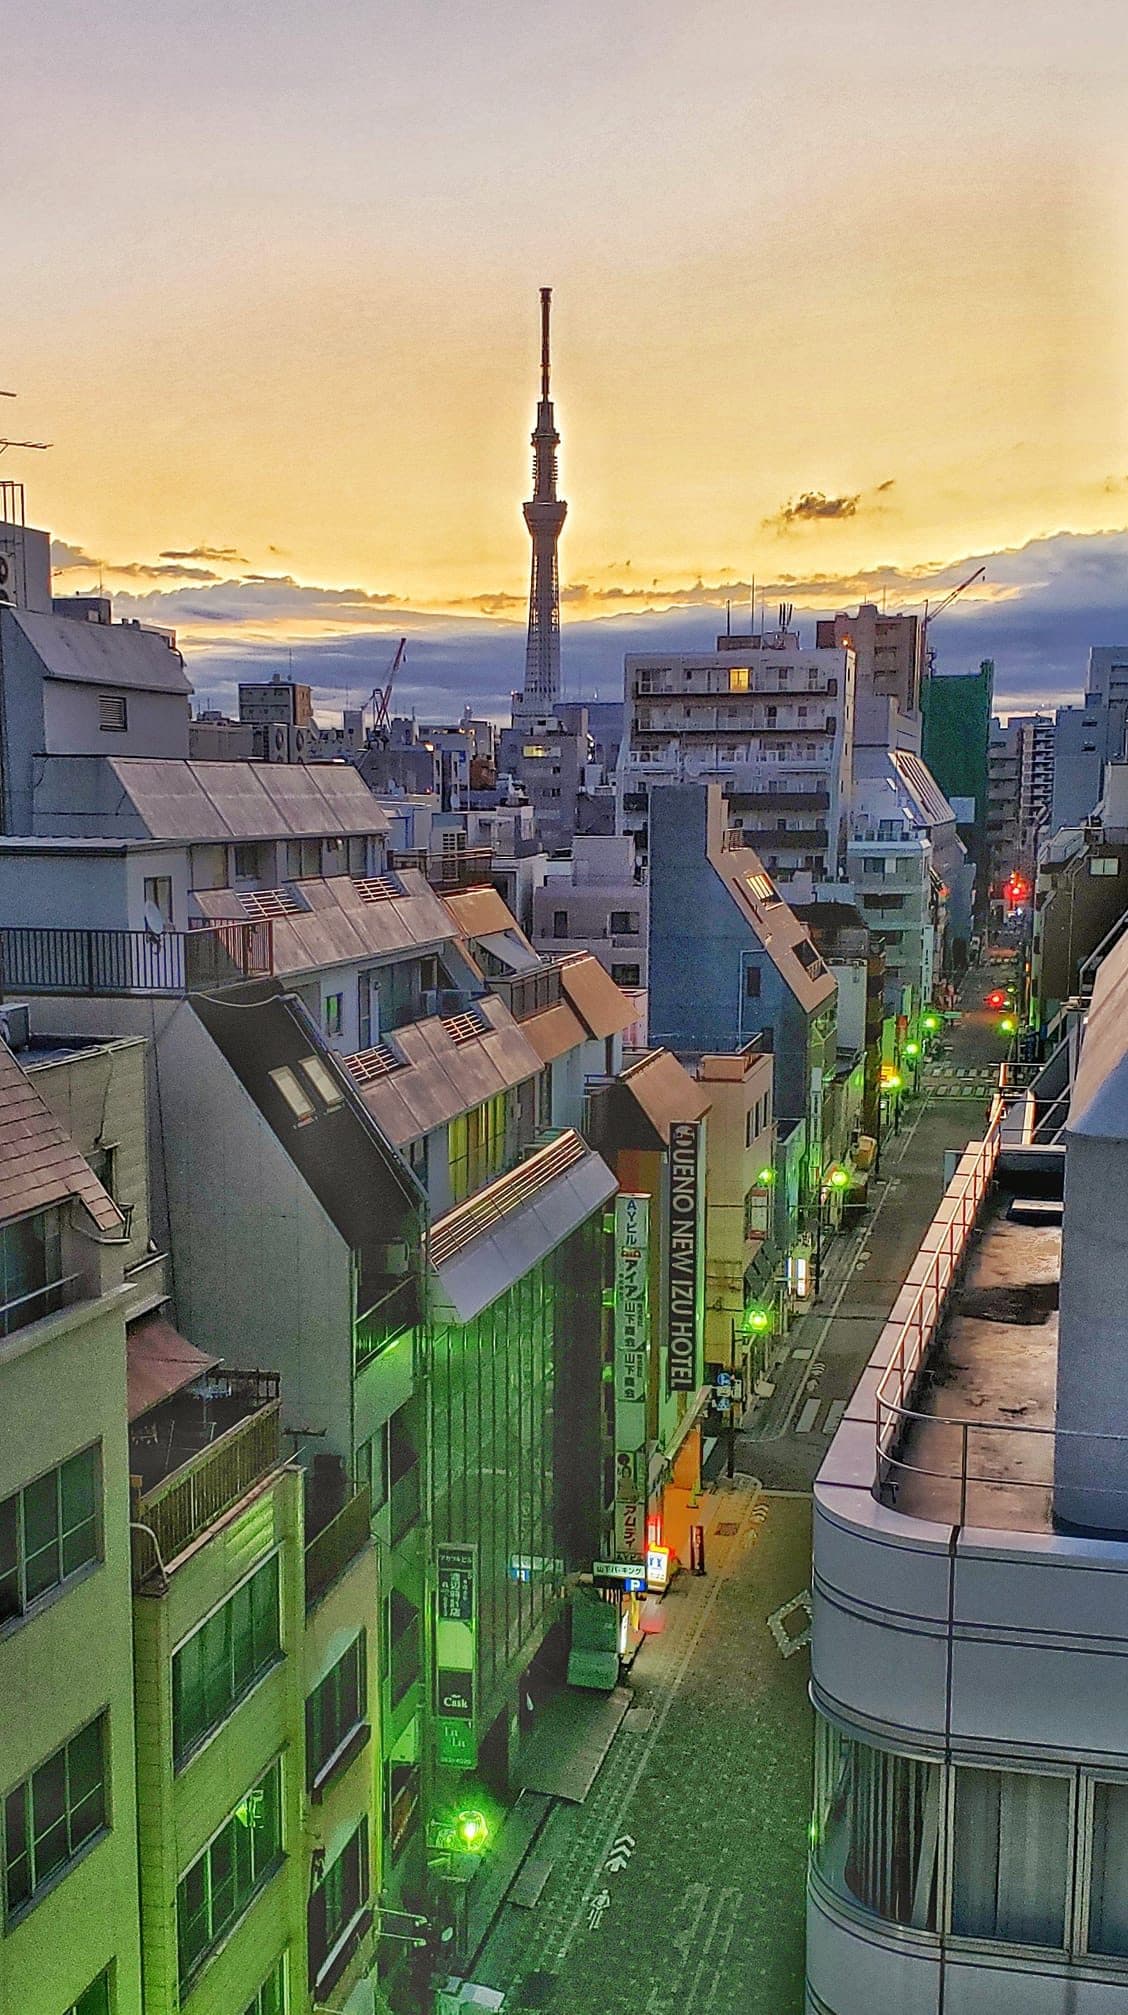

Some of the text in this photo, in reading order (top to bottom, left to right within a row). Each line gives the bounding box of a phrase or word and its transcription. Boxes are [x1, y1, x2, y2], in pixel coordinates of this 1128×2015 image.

[626, 1200, 637, 1245] AYビル
[671, 1149, 695, 1387] UENO NEW IZU HOTEL
[630, 1580, 641, 1592] P
[443, 1697, 468, 1708] Cask
